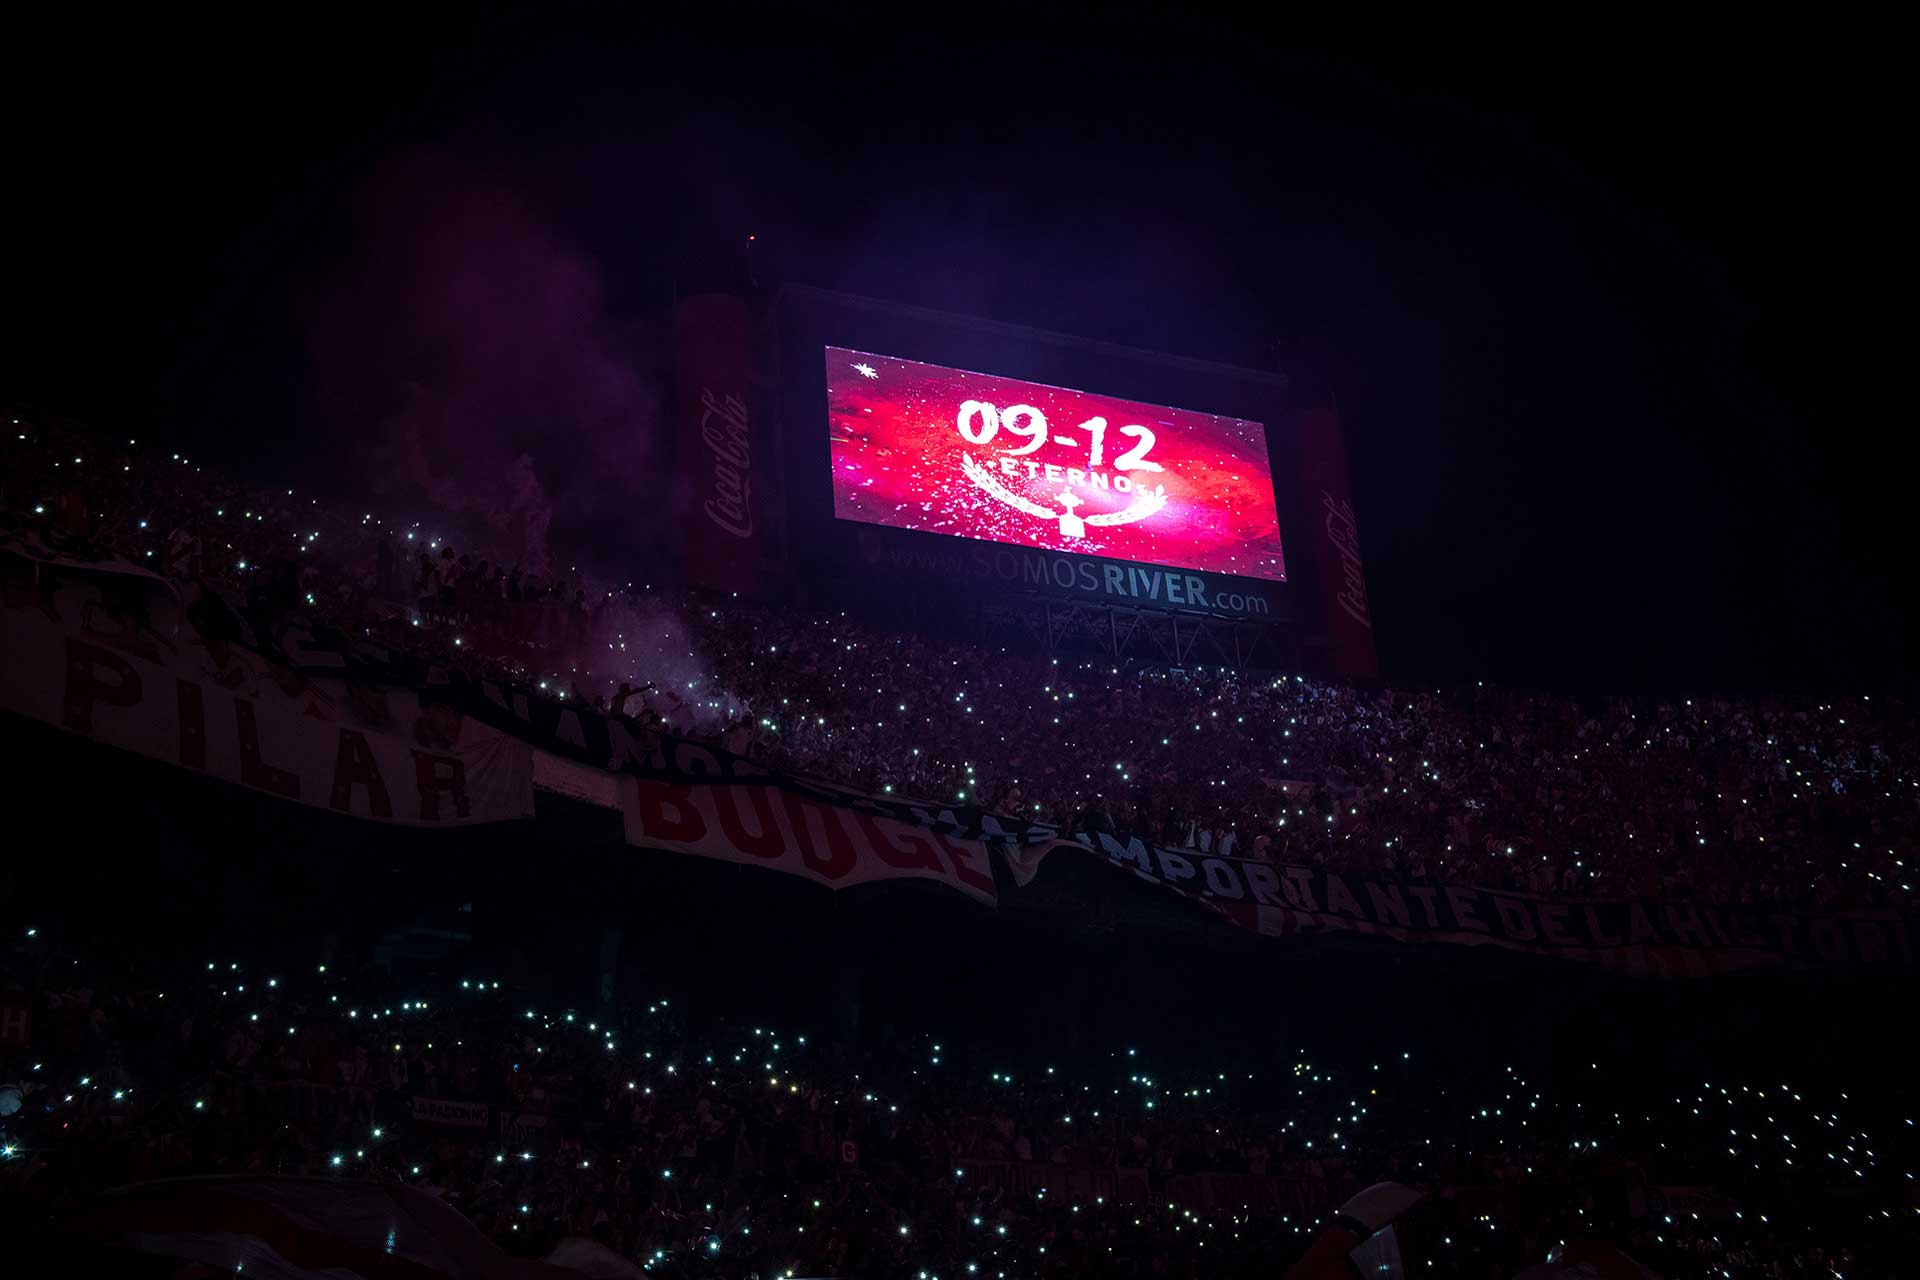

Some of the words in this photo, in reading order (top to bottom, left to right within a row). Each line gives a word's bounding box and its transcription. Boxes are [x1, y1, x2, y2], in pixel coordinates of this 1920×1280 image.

[702, 384, 752, 538] Coca-Cola
[957, 399, 1165, 472] 09-12
[64, 636, 471, 821] PILAR
